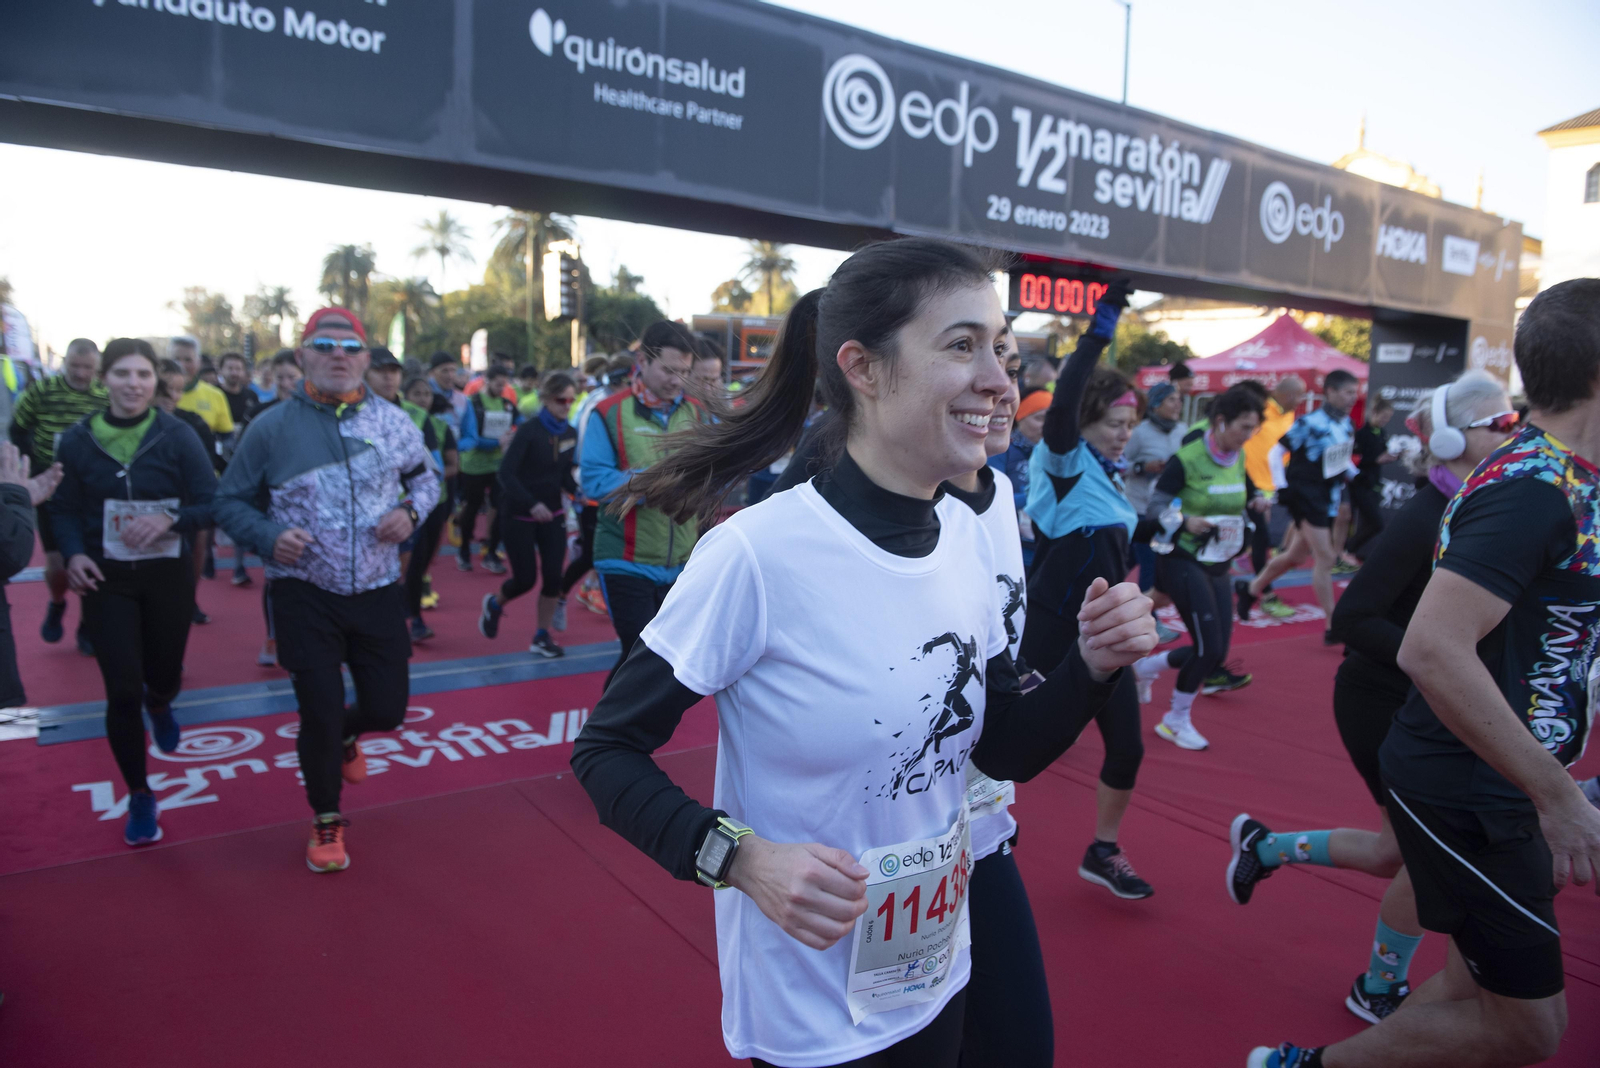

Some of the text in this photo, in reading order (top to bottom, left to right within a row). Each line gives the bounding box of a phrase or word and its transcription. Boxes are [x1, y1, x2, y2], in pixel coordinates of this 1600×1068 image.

[283, 5, 386, 54] Motor
[593, 81, 744, 131] Healthcare Partner
[900, 80, 999, 168] edp
[1058, 118, 1201, 187] maratón
[987, 194, 1110, 240] 29 enero 2023
[1296, 194, 1345, 254] edp
[1376, 223, 1428, 266] HOKA
[902, 846, 934, 868] edp
[877, 849, 968, 942] 11438
[897, 948, 924, 961] Nuria
[903, 983, 925, 994] HOKA
